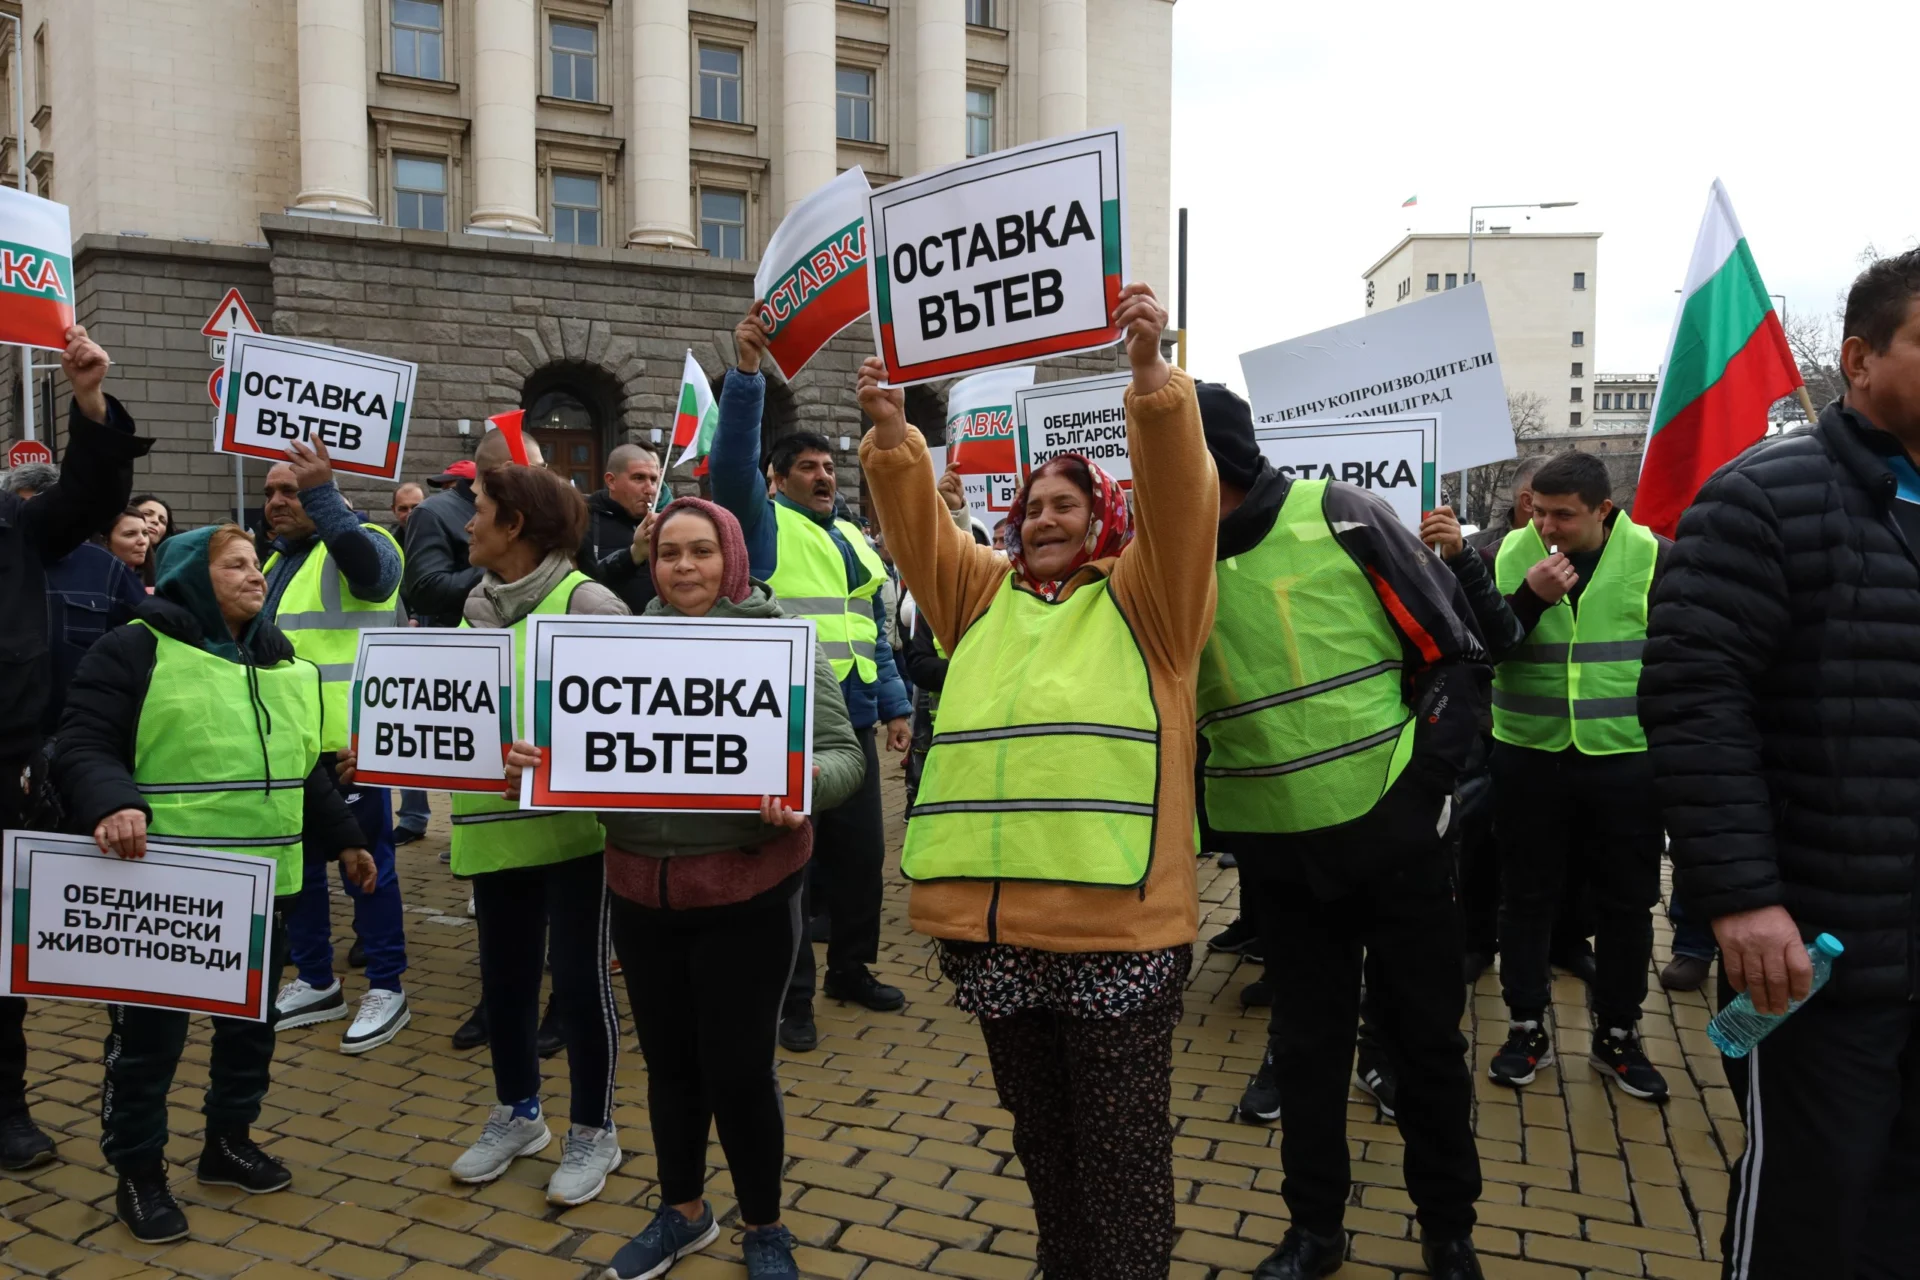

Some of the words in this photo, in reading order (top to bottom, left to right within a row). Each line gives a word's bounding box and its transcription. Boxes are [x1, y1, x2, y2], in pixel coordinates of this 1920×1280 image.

[893, 199, 1096, 284] ОСТАВКА
[0, 248, 67, 299] КА
[917, 268, 1065, 341] ВЪТЕВ
[243, 370, 388, 420] ОСТАВКА
[256, 408, 362, 451] ВЪТЕВ
[12, 452, 48, 465] STOP
[364, 675, 496, 714] ОСТАВКА
[557, 674, 783, 718] ОСТАВКА
[374, 721, 476, 762] ВЪТЕВ
[584, 730, 749, 775] ВЪТЕВ
[63, 883, 224, 919] ОБЕДИНЕНИ
[63, 908, 221, 943] БЪЛГАРСКИ
[36, 930, 242, 971] ЖИВОТНОВЪДИ
